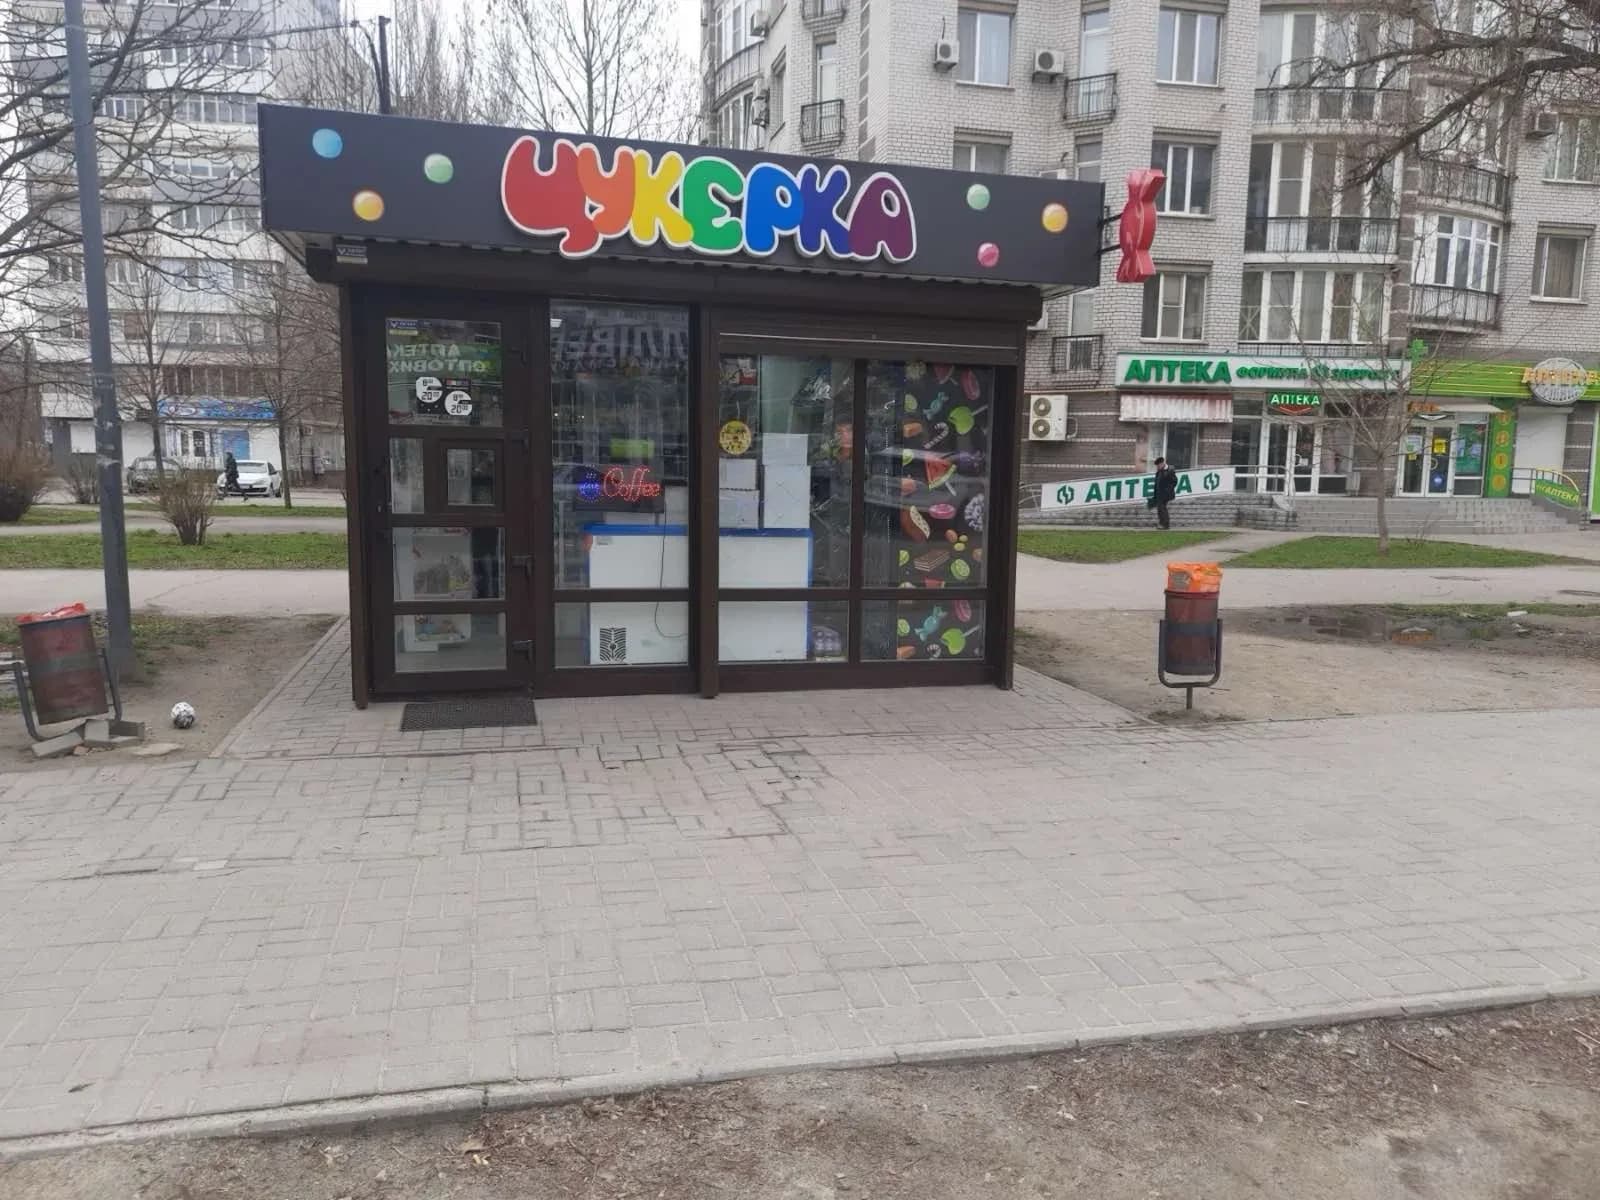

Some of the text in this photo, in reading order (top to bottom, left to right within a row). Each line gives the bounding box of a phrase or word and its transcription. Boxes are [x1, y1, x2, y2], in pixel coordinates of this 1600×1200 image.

[501, 135, 918, 262] ЦУКЕРКА
[1124, 359, 1232, 384] АПТЕКА
[1271, 393, 1320, 405] АПТЕКА
[603, 465, 660, 502] Coffee
[1085, 474, 1193, 503] АПТЕА
